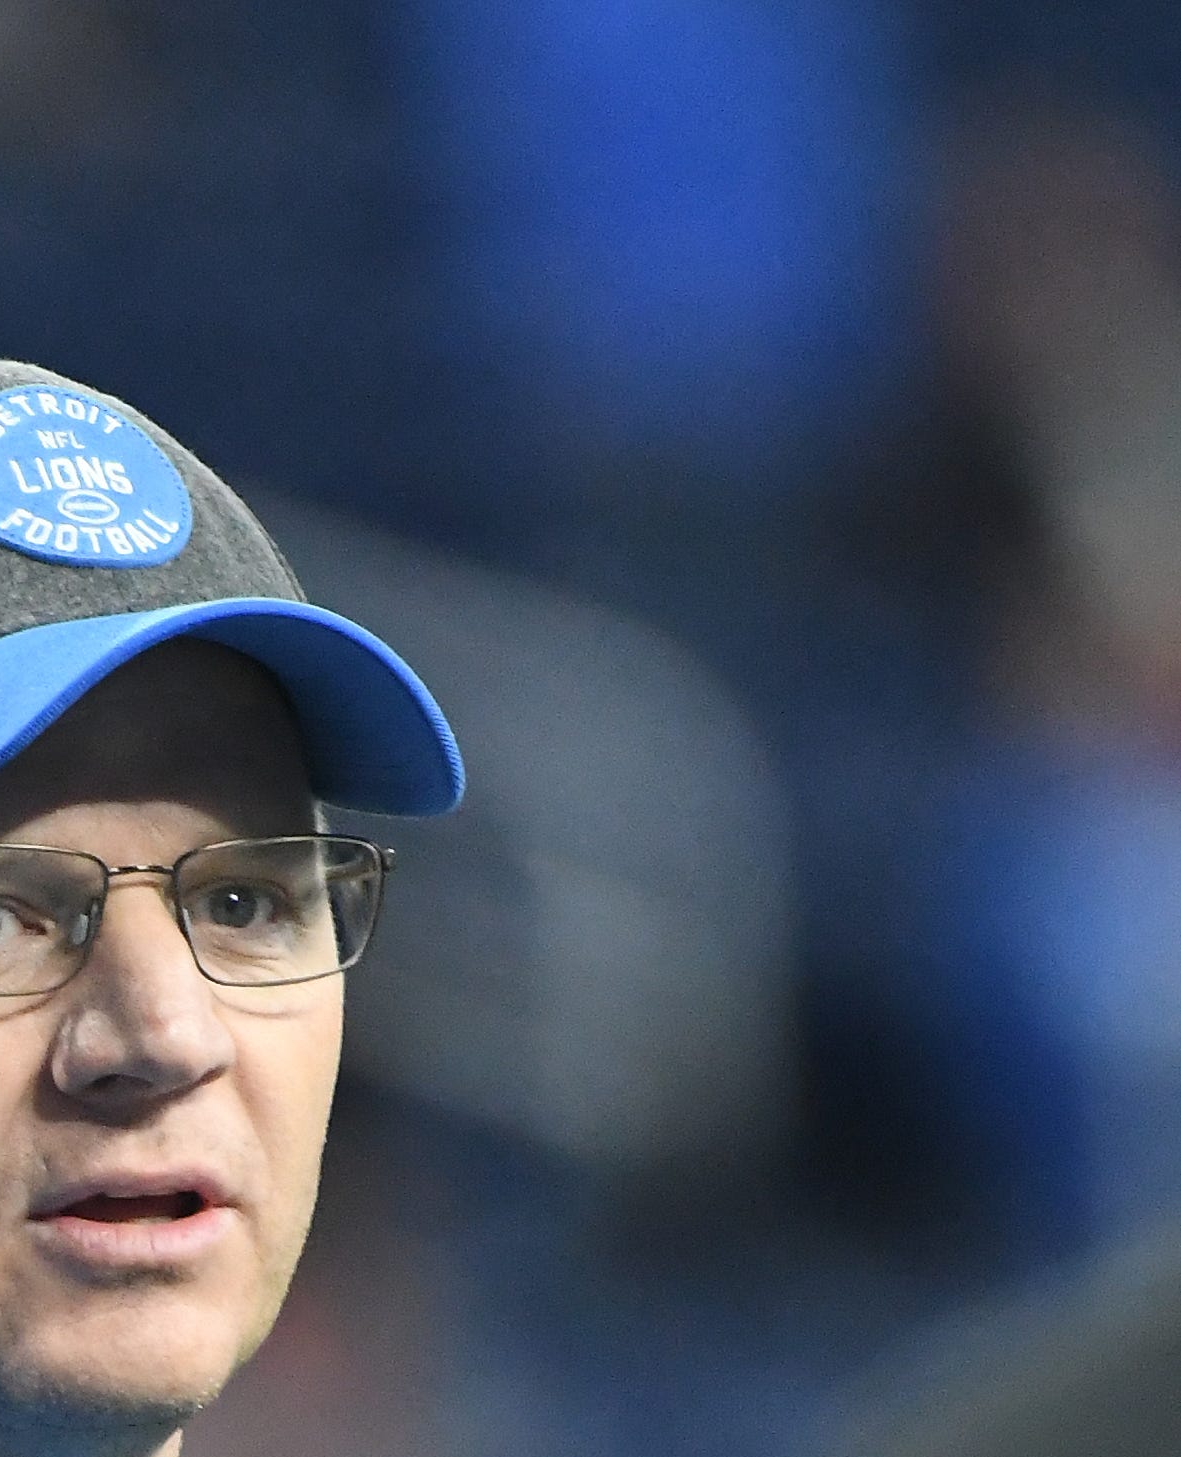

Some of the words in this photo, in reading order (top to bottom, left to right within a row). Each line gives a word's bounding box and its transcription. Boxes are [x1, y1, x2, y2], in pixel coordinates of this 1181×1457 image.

[36, 430, 85, 449] NFL
[9, 456, 134, 495] LIONS
[0, 508, 180, 555] FOOTBALL
